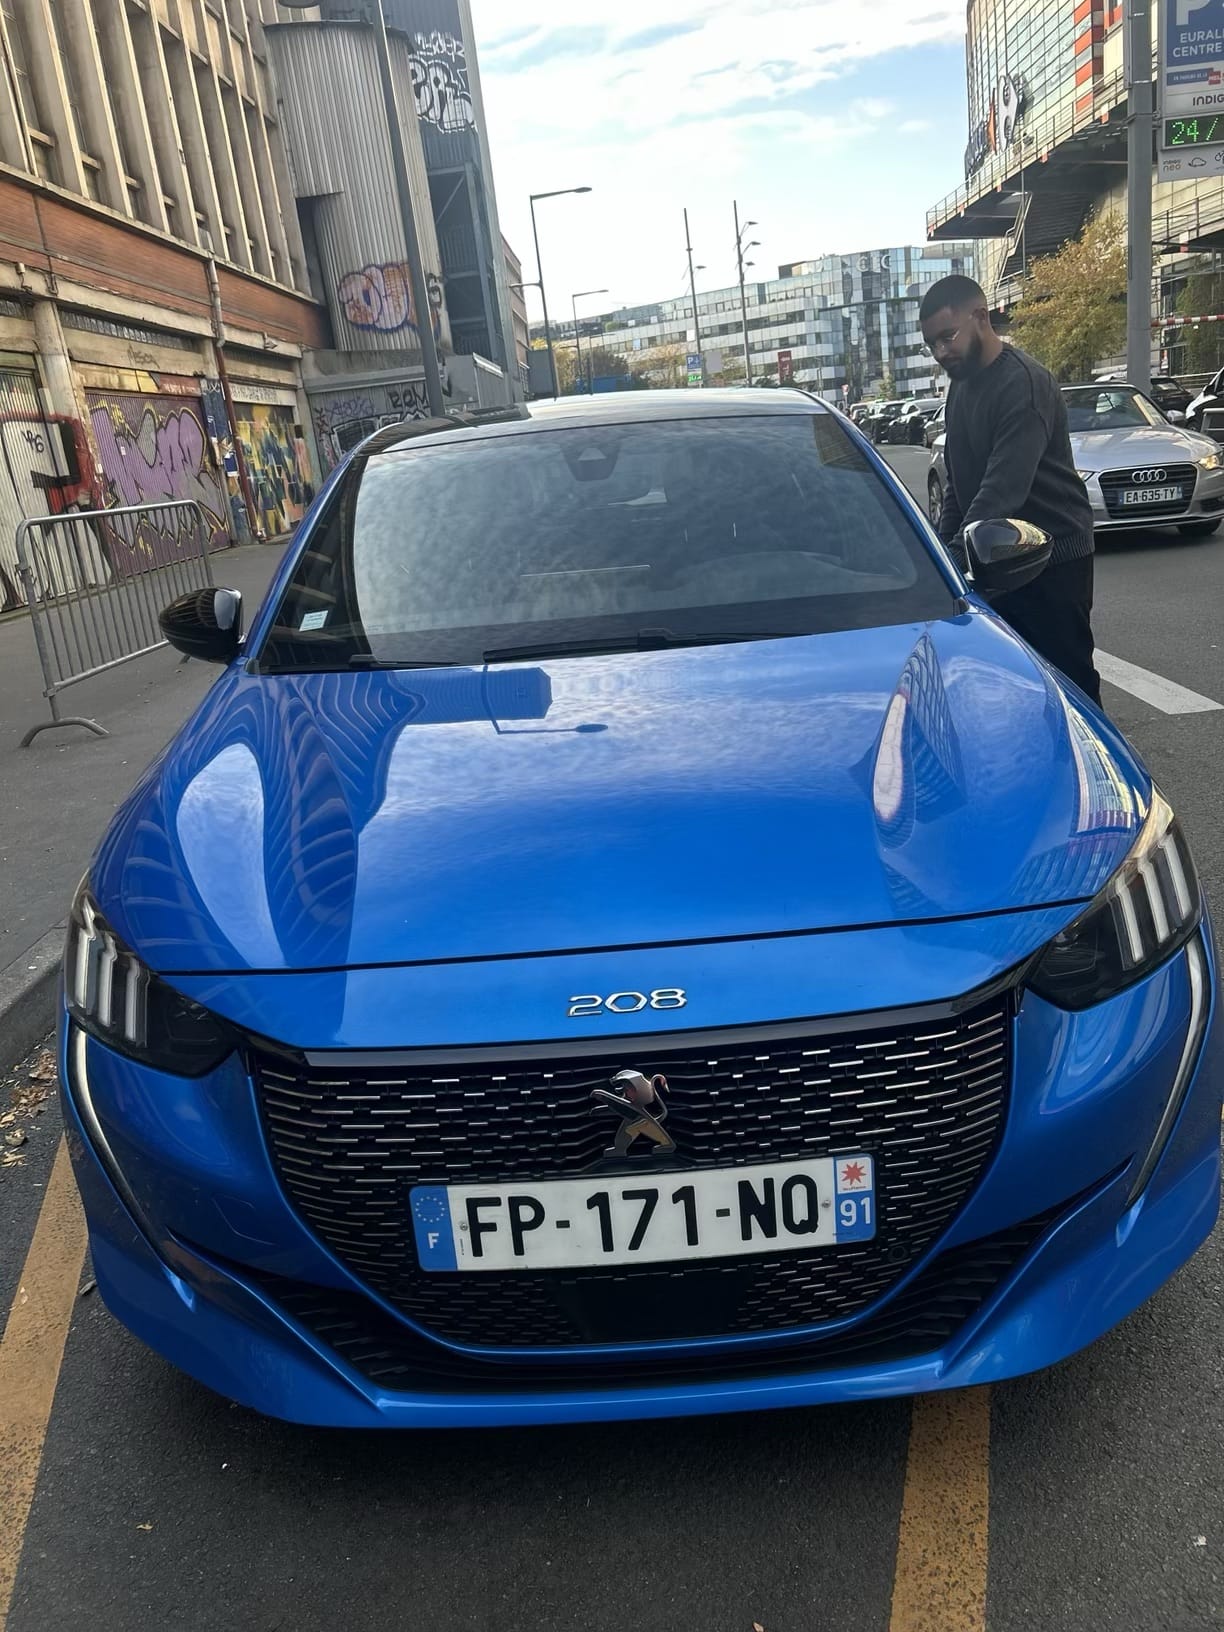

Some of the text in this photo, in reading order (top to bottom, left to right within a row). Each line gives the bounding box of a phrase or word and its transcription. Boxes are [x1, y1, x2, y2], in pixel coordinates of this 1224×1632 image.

[1173, 42, 1222, 57] CENTRE
[1126, 488, 1176, 503] EA-635-TY
[568, 988, 687, 1017] 208
[465, 1173, 819, 1257] FP-171-NQ
[840, 1197, 870, 1226] 91
[427, 1233, 439, 1249] F
